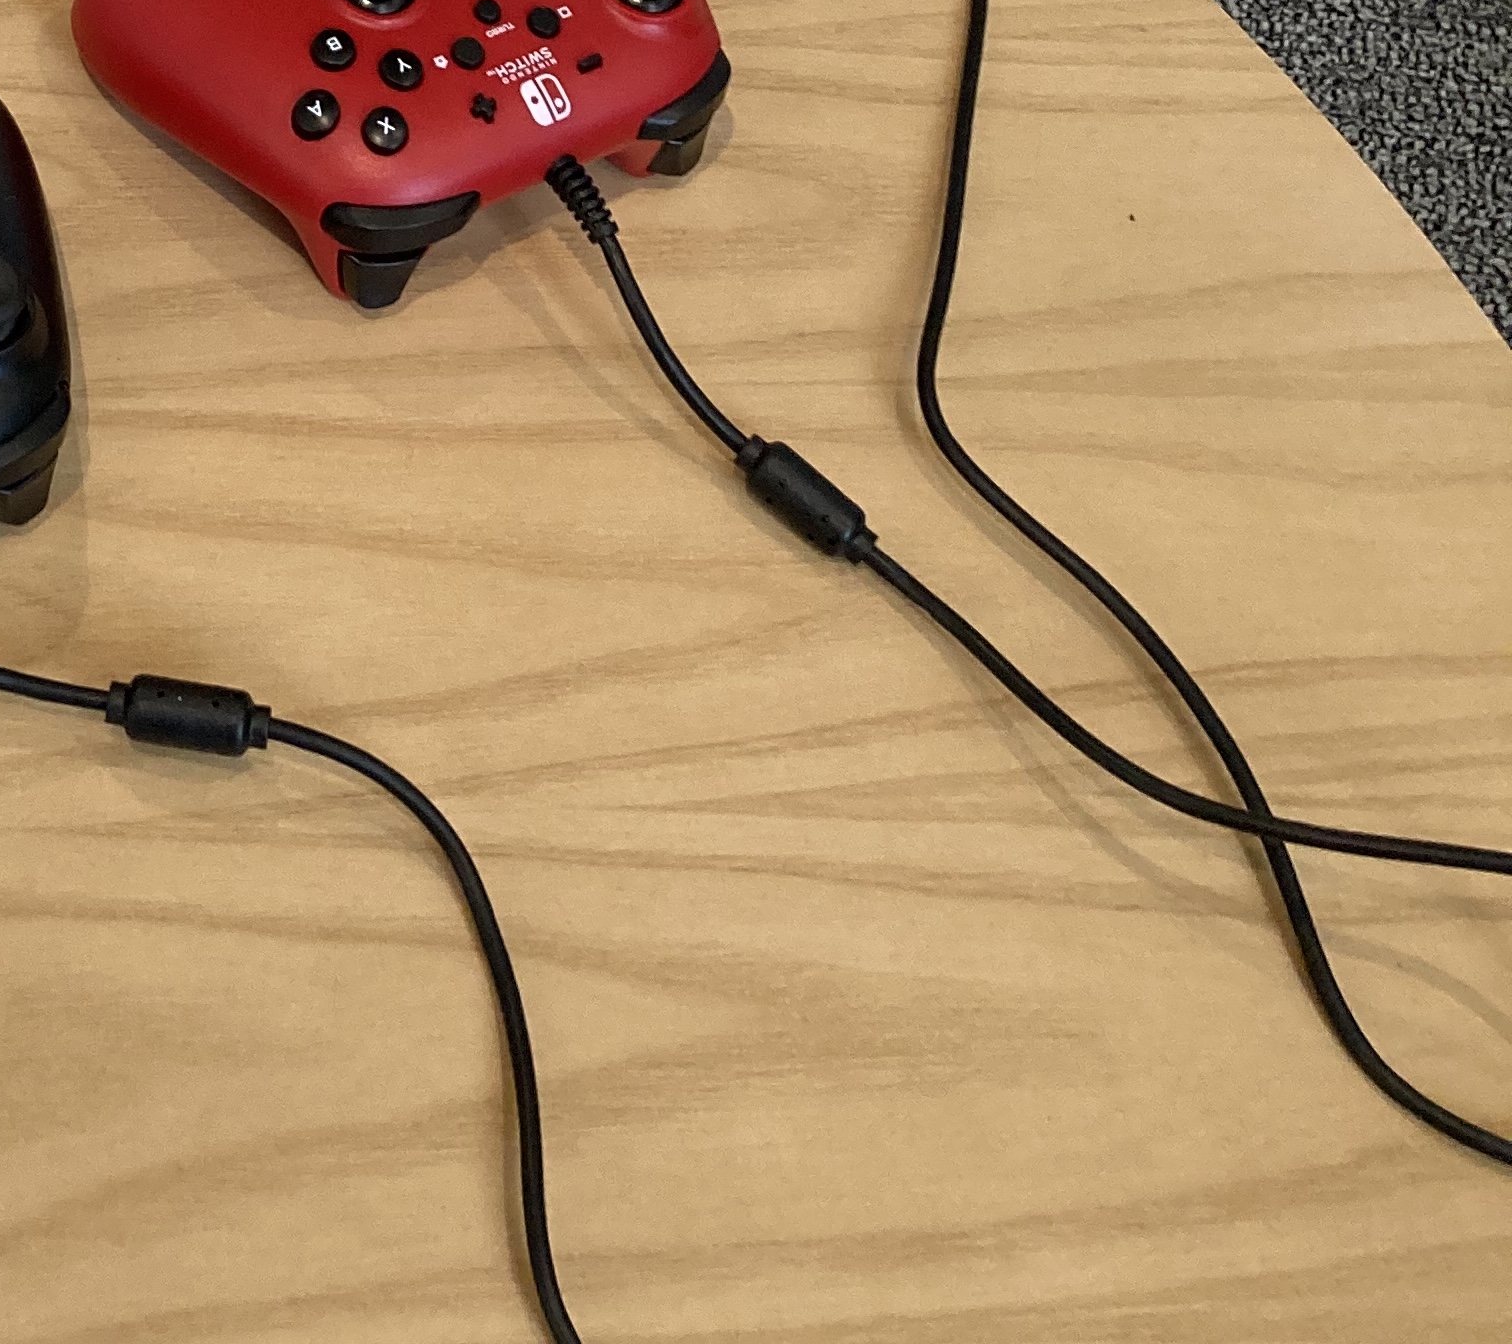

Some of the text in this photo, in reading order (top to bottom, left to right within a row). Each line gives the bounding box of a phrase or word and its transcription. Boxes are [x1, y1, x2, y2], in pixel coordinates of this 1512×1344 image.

[325, 36, 343, 53] B
[395, 57, 413, 73] Y
[493, 46, 553, 79] SWITCH
[306, 99, 324, 117] A
[377, 117, 396, 135] X
